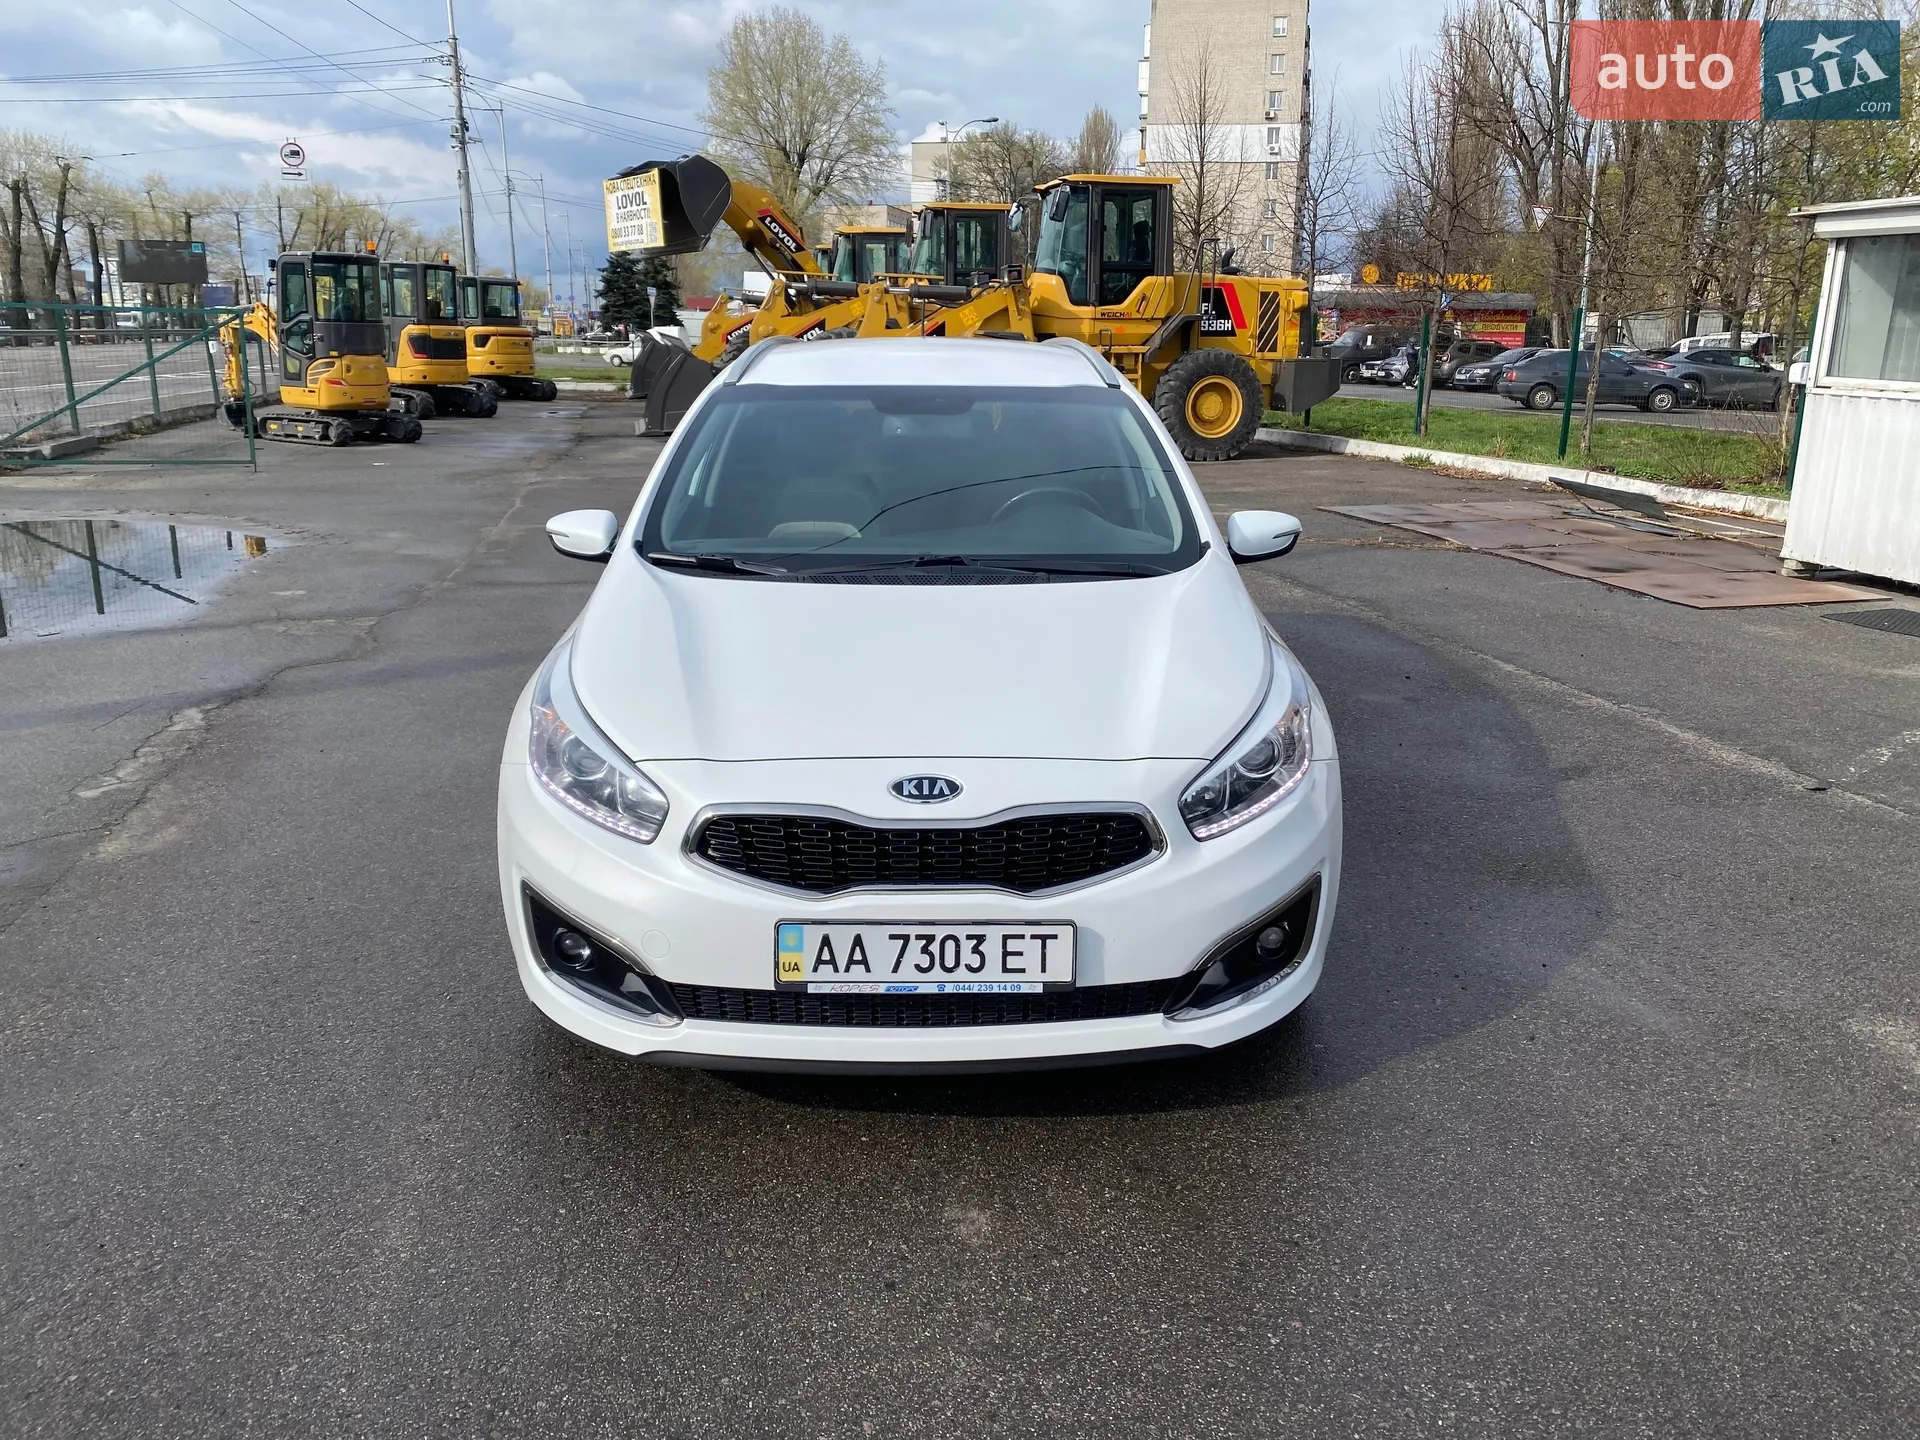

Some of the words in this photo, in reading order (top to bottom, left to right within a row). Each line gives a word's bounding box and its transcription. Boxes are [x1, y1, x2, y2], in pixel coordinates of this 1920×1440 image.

[606, 181, 619, 194] НОВА
[620, 173, 657, 192] СПЕЦТЕХНІКА
[616, 191, 647, 210] LOVOL
[611, 227, 623, 239] 0800
[623, 226, 630, 237] 33
[630, 225, 636, 236] 77
[637, 224, 643, 235] 88
[764, 216, 797, 252] LOVOL
[1200, 319, 1232, 331] 936H
[1481, 323, 1518, 331] ПРОДУКТИ
[799, 326, 824, 342] VOL
[902, 779, 951, 796] KIA
[811, 932, 872, 974] AA
[887, 933, 987, 974] 7303
[1001, 933, 1059, 974] ET
[782, 961, 801, 973] UA
[952, 984, 975, 992] /044/
[977, 984, 994, 992] 239
[997, 984, 1007, 992] 14
[1010, 984, 1022, 992] 09
